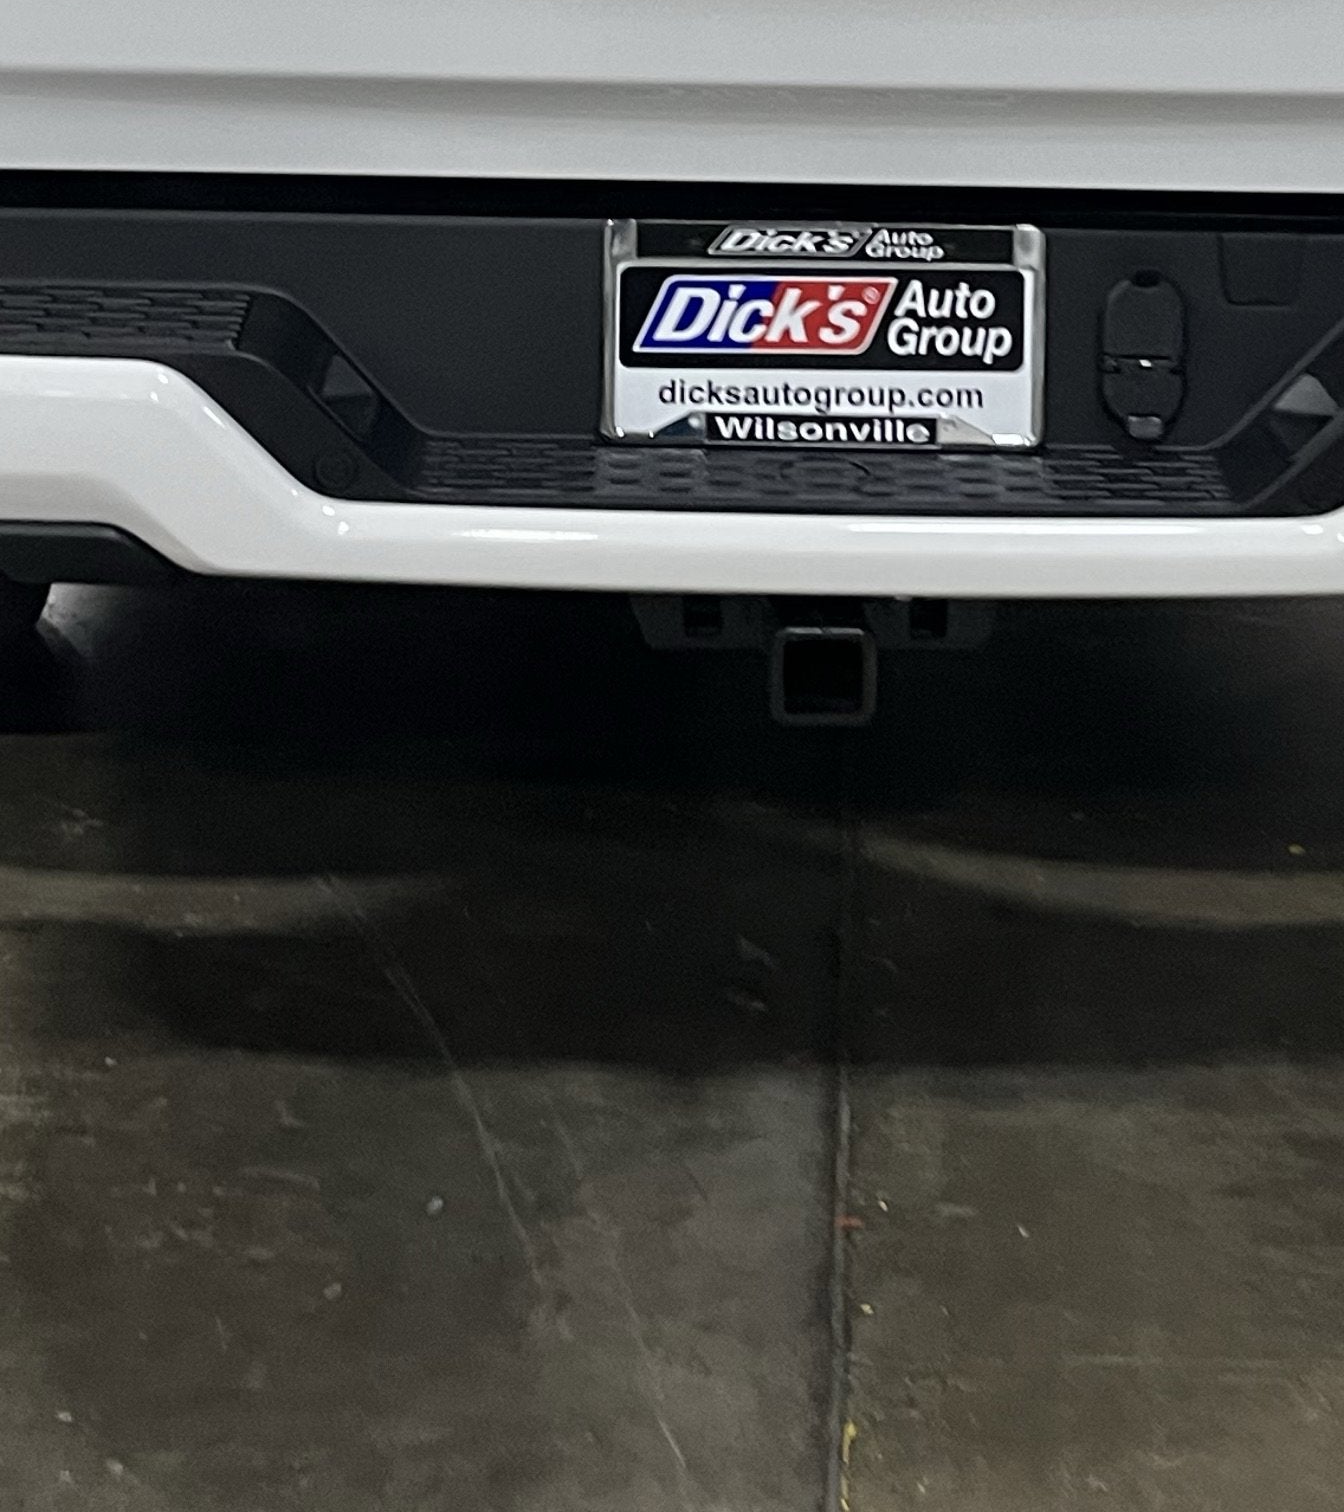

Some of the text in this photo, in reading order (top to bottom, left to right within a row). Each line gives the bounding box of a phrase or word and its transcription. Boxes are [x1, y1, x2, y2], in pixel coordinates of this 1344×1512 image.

[720, 228, 856, 254] Dick's
[864, 242, 946, 261] Group
[871, 228, 934, 246] Auto
[652, 285, 868, 344] Dick's
[893, 280, 996, 319] Auto
[887, 318, 1013, 365] Group
[658, 379, 984, 414] dicksautogroup.com
[714, 415, 931, 442] Wilsonville
